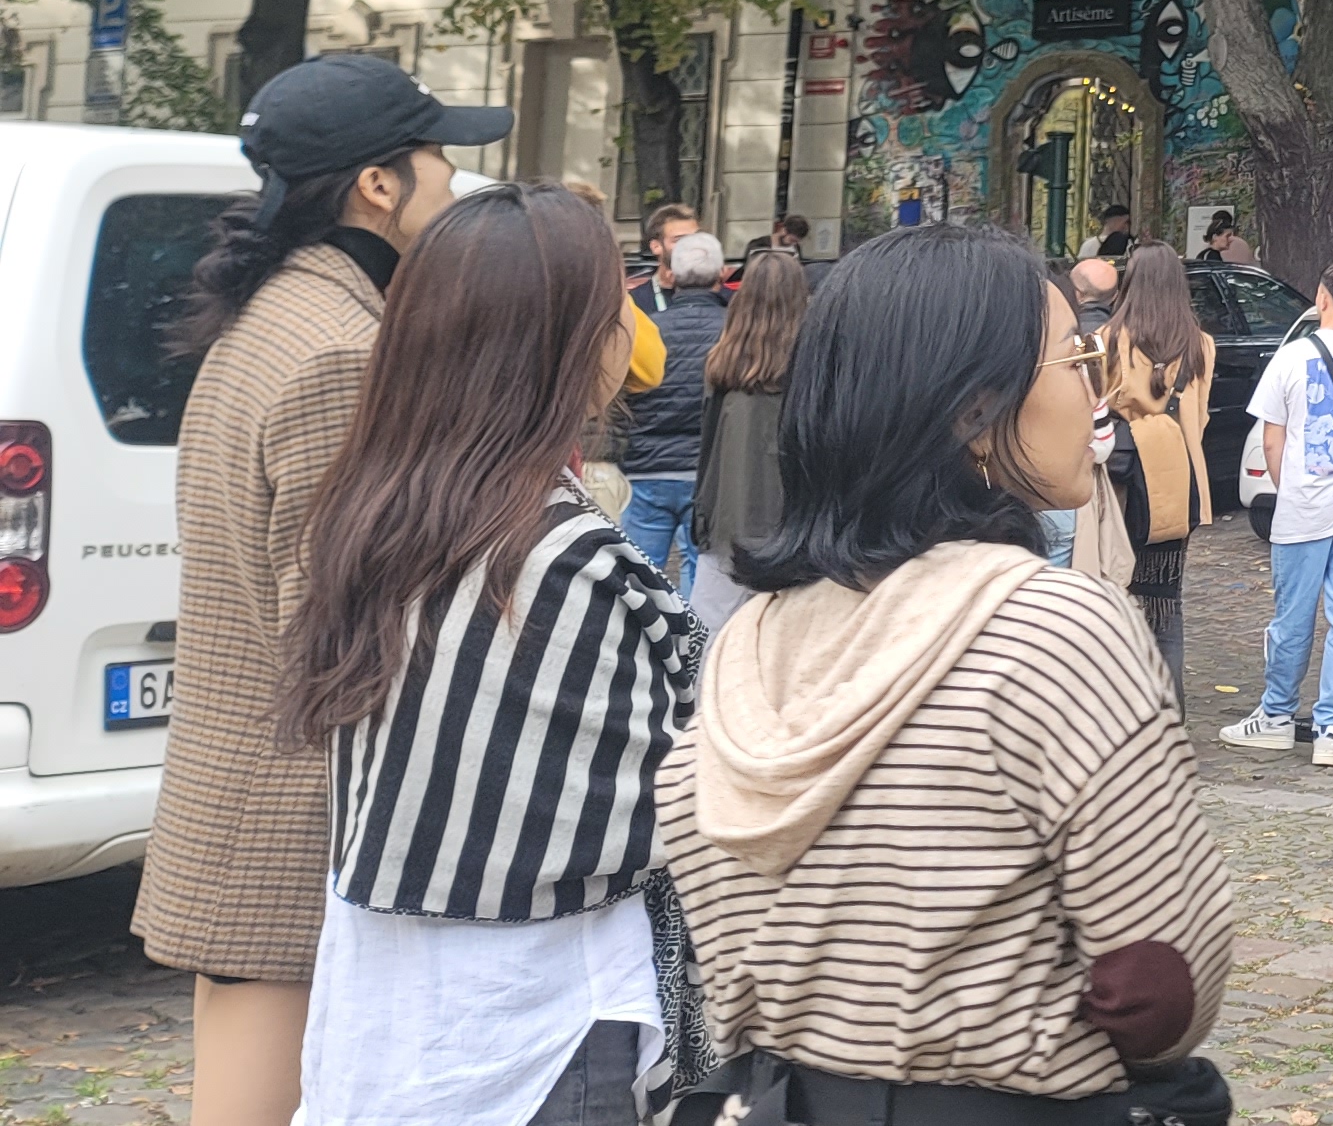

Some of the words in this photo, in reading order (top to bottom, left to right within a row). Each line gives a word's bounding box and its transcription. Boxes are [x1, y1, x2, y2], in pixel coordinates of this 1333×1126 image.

[82, 543, 181, 560] PEUGEO
[140, 672, 175, 710] 6A
[110, 701, 128, 714] CZ
